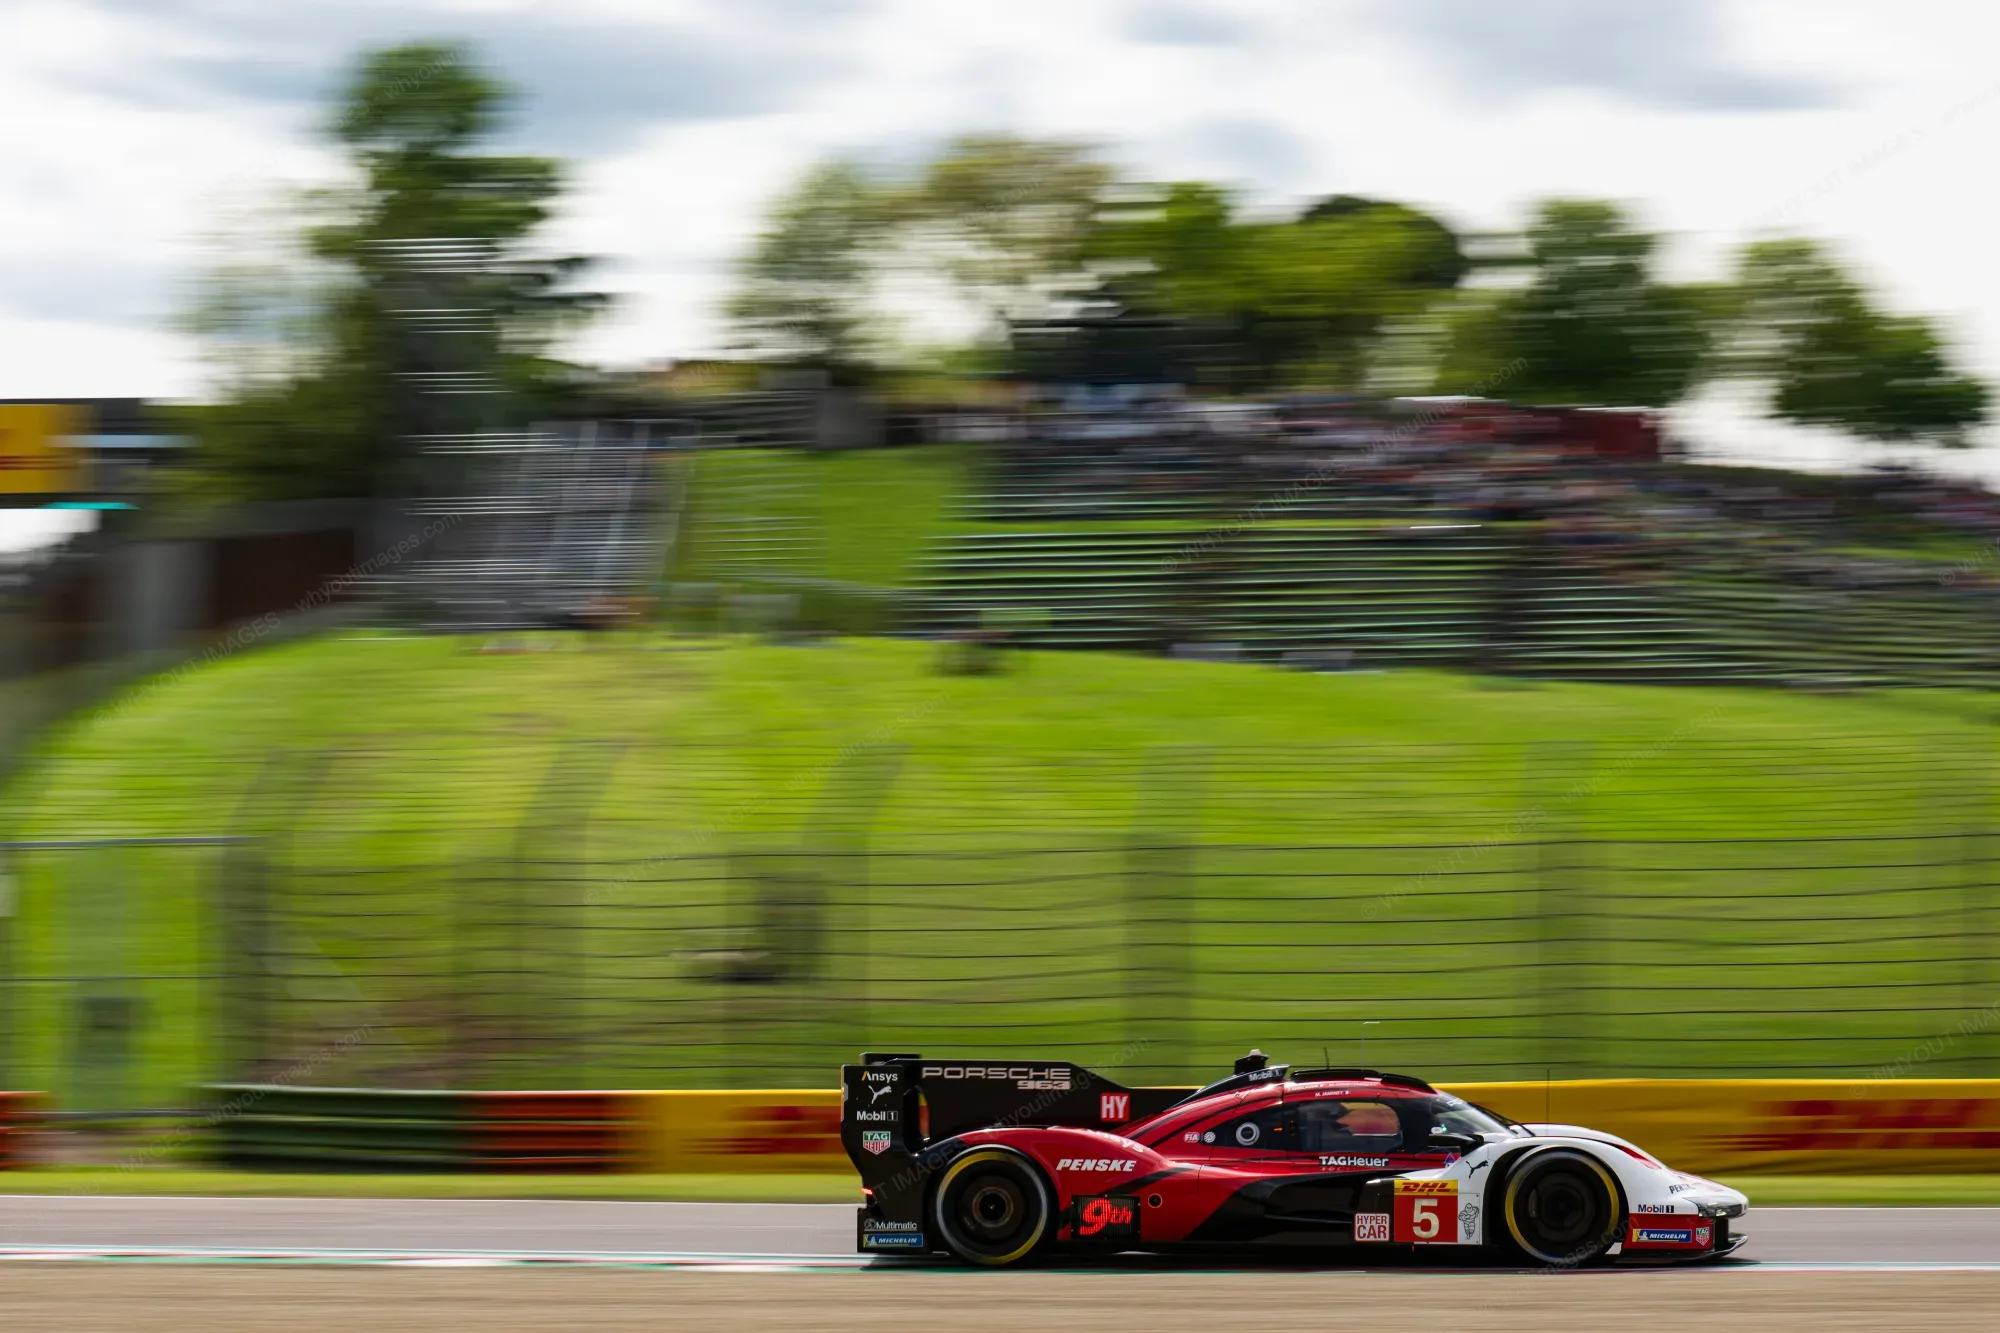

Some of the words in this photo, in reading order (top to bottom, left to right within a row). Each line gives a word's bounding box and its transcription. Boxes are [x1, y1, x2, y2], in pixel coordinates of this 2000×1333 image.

[861, 1071, 898, 1083] Ansys
[922, 1067, 1071, 1079] PORSCHE
[1248, 1072, 1272, 1082] Mobil
[1017, 1081, 1071, 1089] 963
[1102, 1095, 1128, 1118] HY
[857, 1111, 886, 1121] Mobil
[1184, 1133, 1199, 1141] FIA
[1056, 1159, 1137, 1172] PENSKE
[1402, 1182, 1452, 1192] DHL
[1669, 1184, 1696, 1194] PEN
[1638, 1204, 1664, 1213] Mobil
[1079, 1198, 1132, 1235] 9th
[1357, 1215, 1387, 1224] HYPER
[1412, 1198, 1440, 1239] 5
[877, 1221, 917, 1229] Multimatic
[1357, 1225, 1387, 1239] CAR
